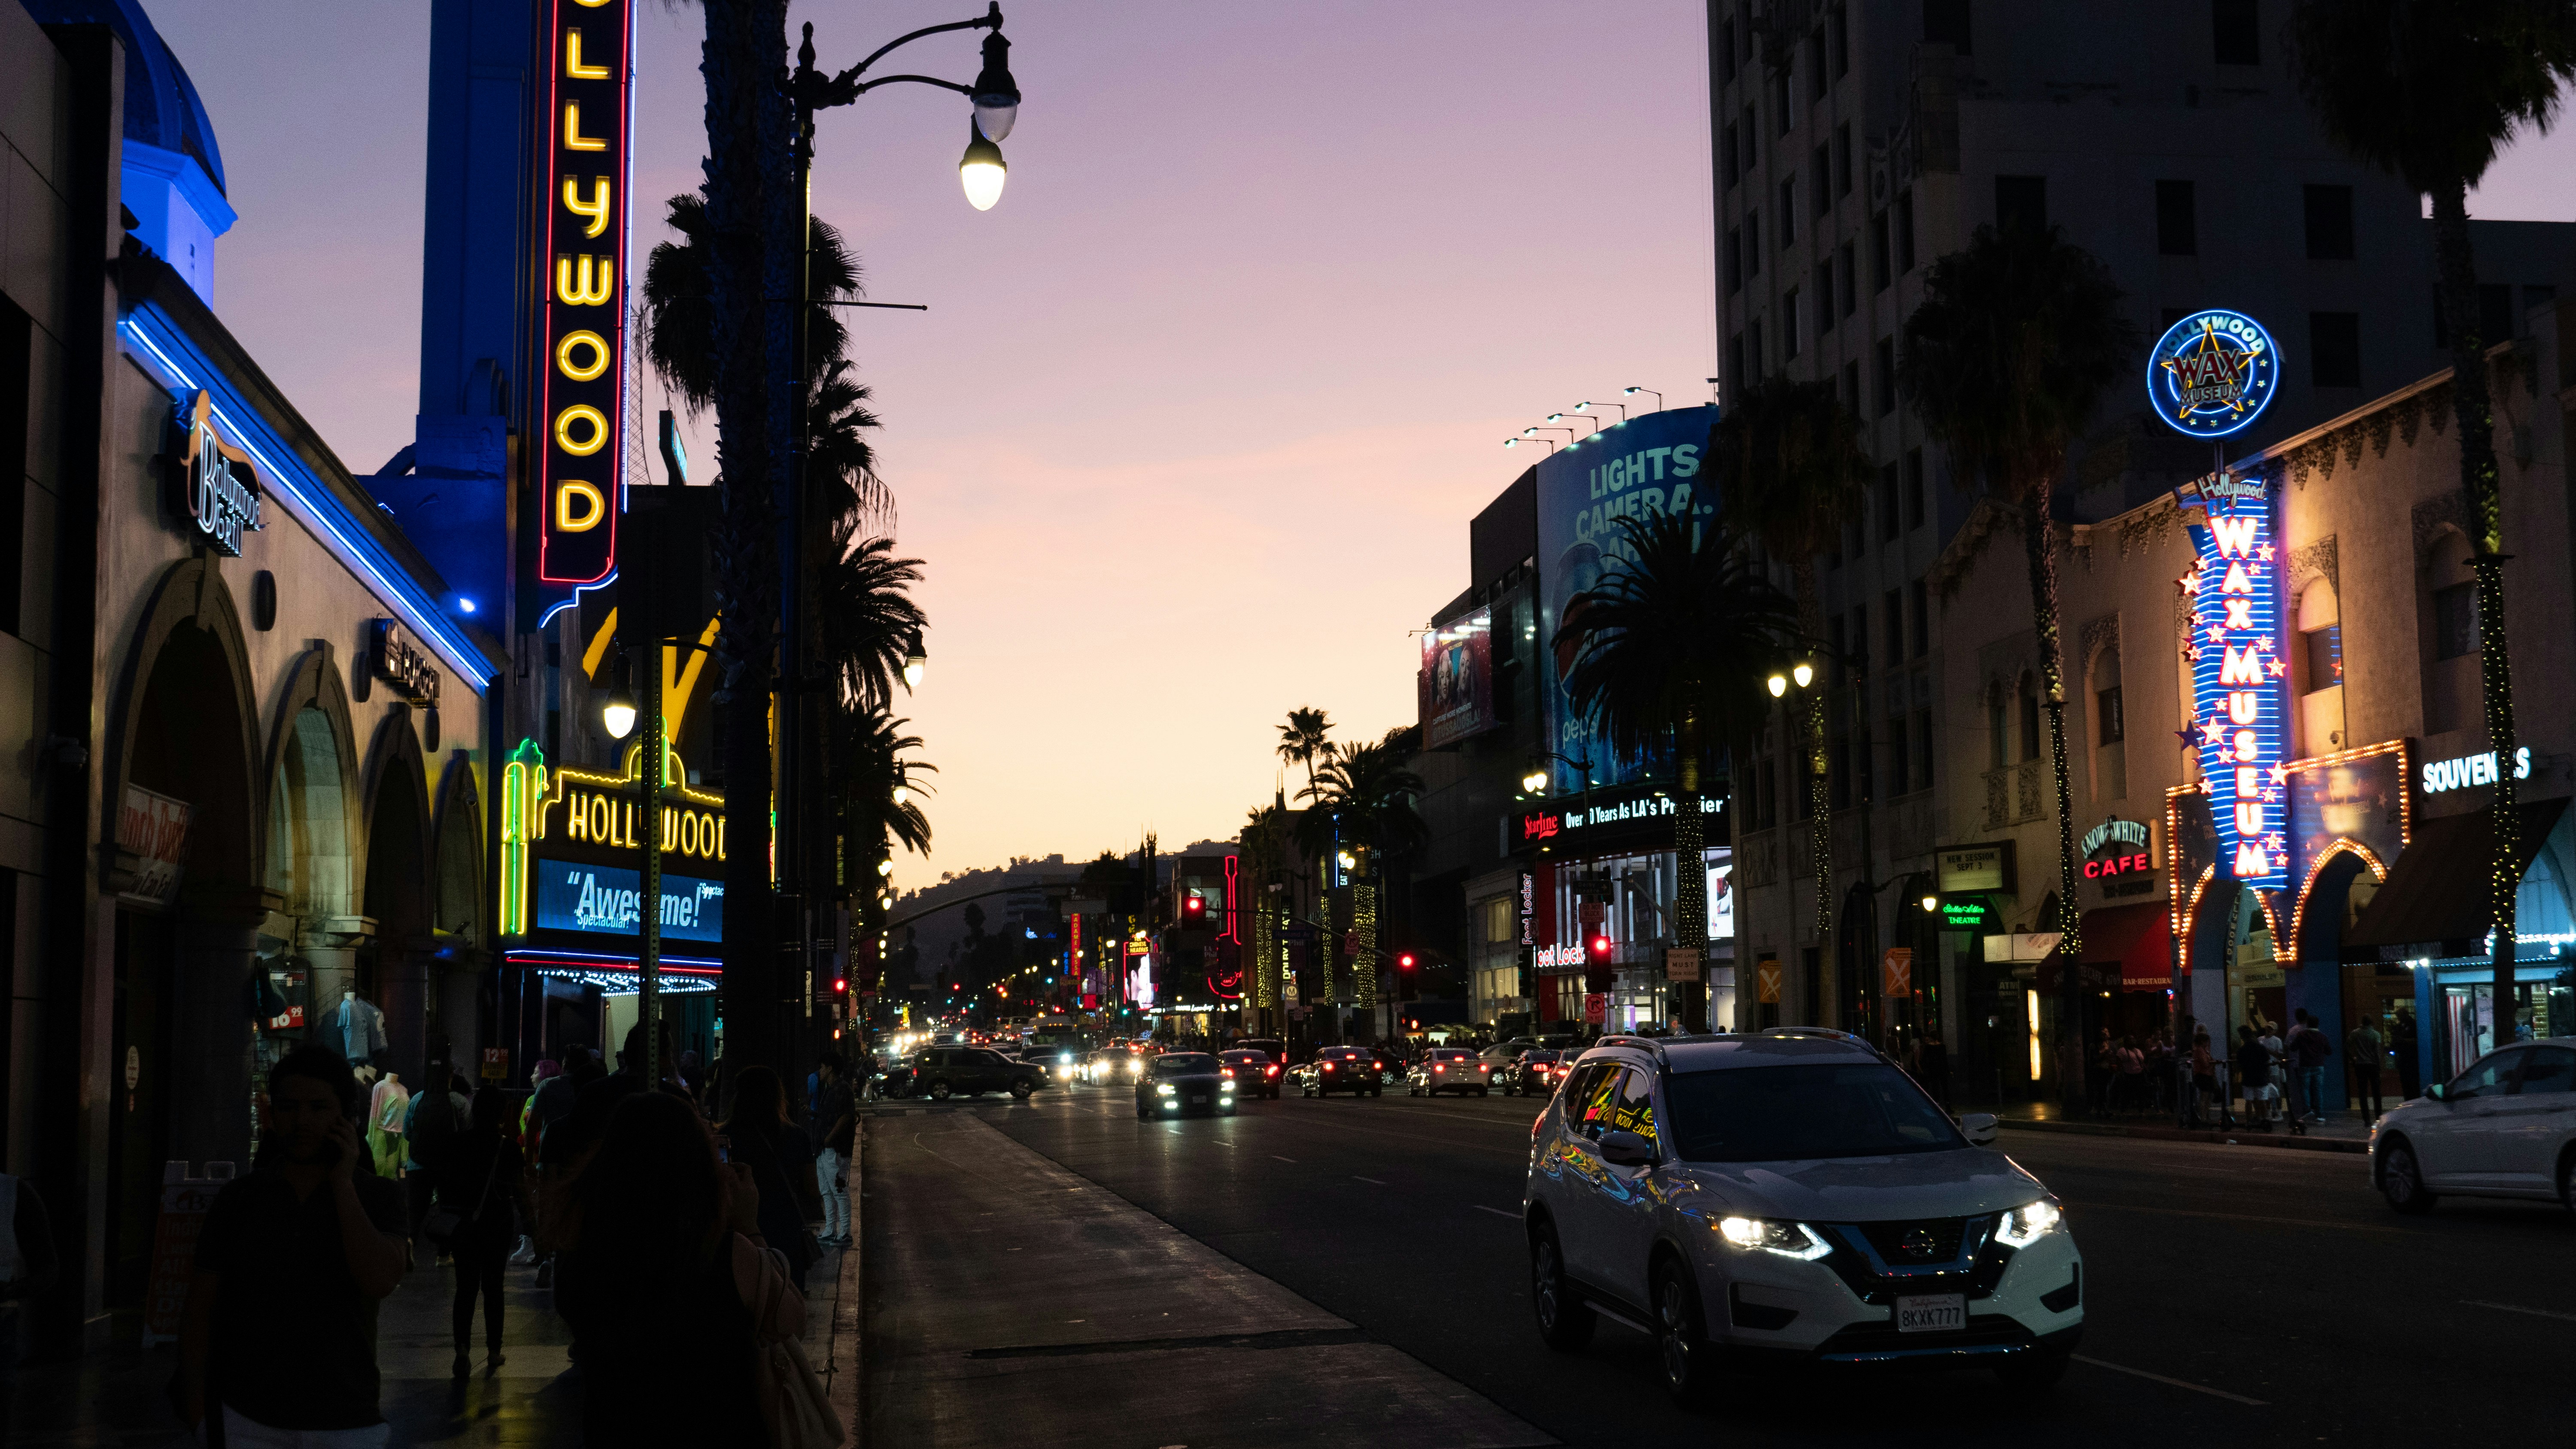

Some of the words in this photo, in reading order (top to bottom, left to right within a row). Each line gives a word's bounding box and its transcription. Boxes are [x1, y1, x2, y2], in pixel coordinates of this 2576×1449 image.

[554, 0, 614, 532] LLYWOOD
[2159, 316, 2266, 361] HOLLYWOOD
[2172, 348, 2242, 389] WAX
[2178, 383, 2245, 405] MUSEUM
[2197, 473, 2267, 507] Hollywood
[2207, 516, 2258, 630] WAX
[2218, 640, 2271, 877] MUSEUM
[2423, 746, 2530, 794] SOUVENS
[569, 790, 727, 861] HOLLWOO
[1565, 812, 1583, 829] Over
[1596, 805, 1618, 824] Years
[1619, 802, 1630, 820] As
[1632, 799, 1657, 818] LA's
[1661, 795, 1724, 815] Prier
[2081, 818, 2110, 859] SNOW
[2110, 820, 2147, 847] WHITE
[1947, 855, 1962, 863] NEW
[1965, 852, 1995, 862] SESSION
[1956, 862, 1974, 871] SEPT
[1978, 861, 1983, 870] 3
[2084, 853, 2147, 879] CAFE
[1521, 873, 1533, 915] Locker
[1522, 917, 1533, 945] Foot
[1533, 944, 1556, 968] oot
[1556, 940, 1586, 966] Lock
[2123, 977, 2172, 986] BAR-RESTAURA
[291, 1006, 303, 1016] 99
[486, 1048, 498, 1062] 12
[1902, 1307, 1959, 1327] 8KXK777
